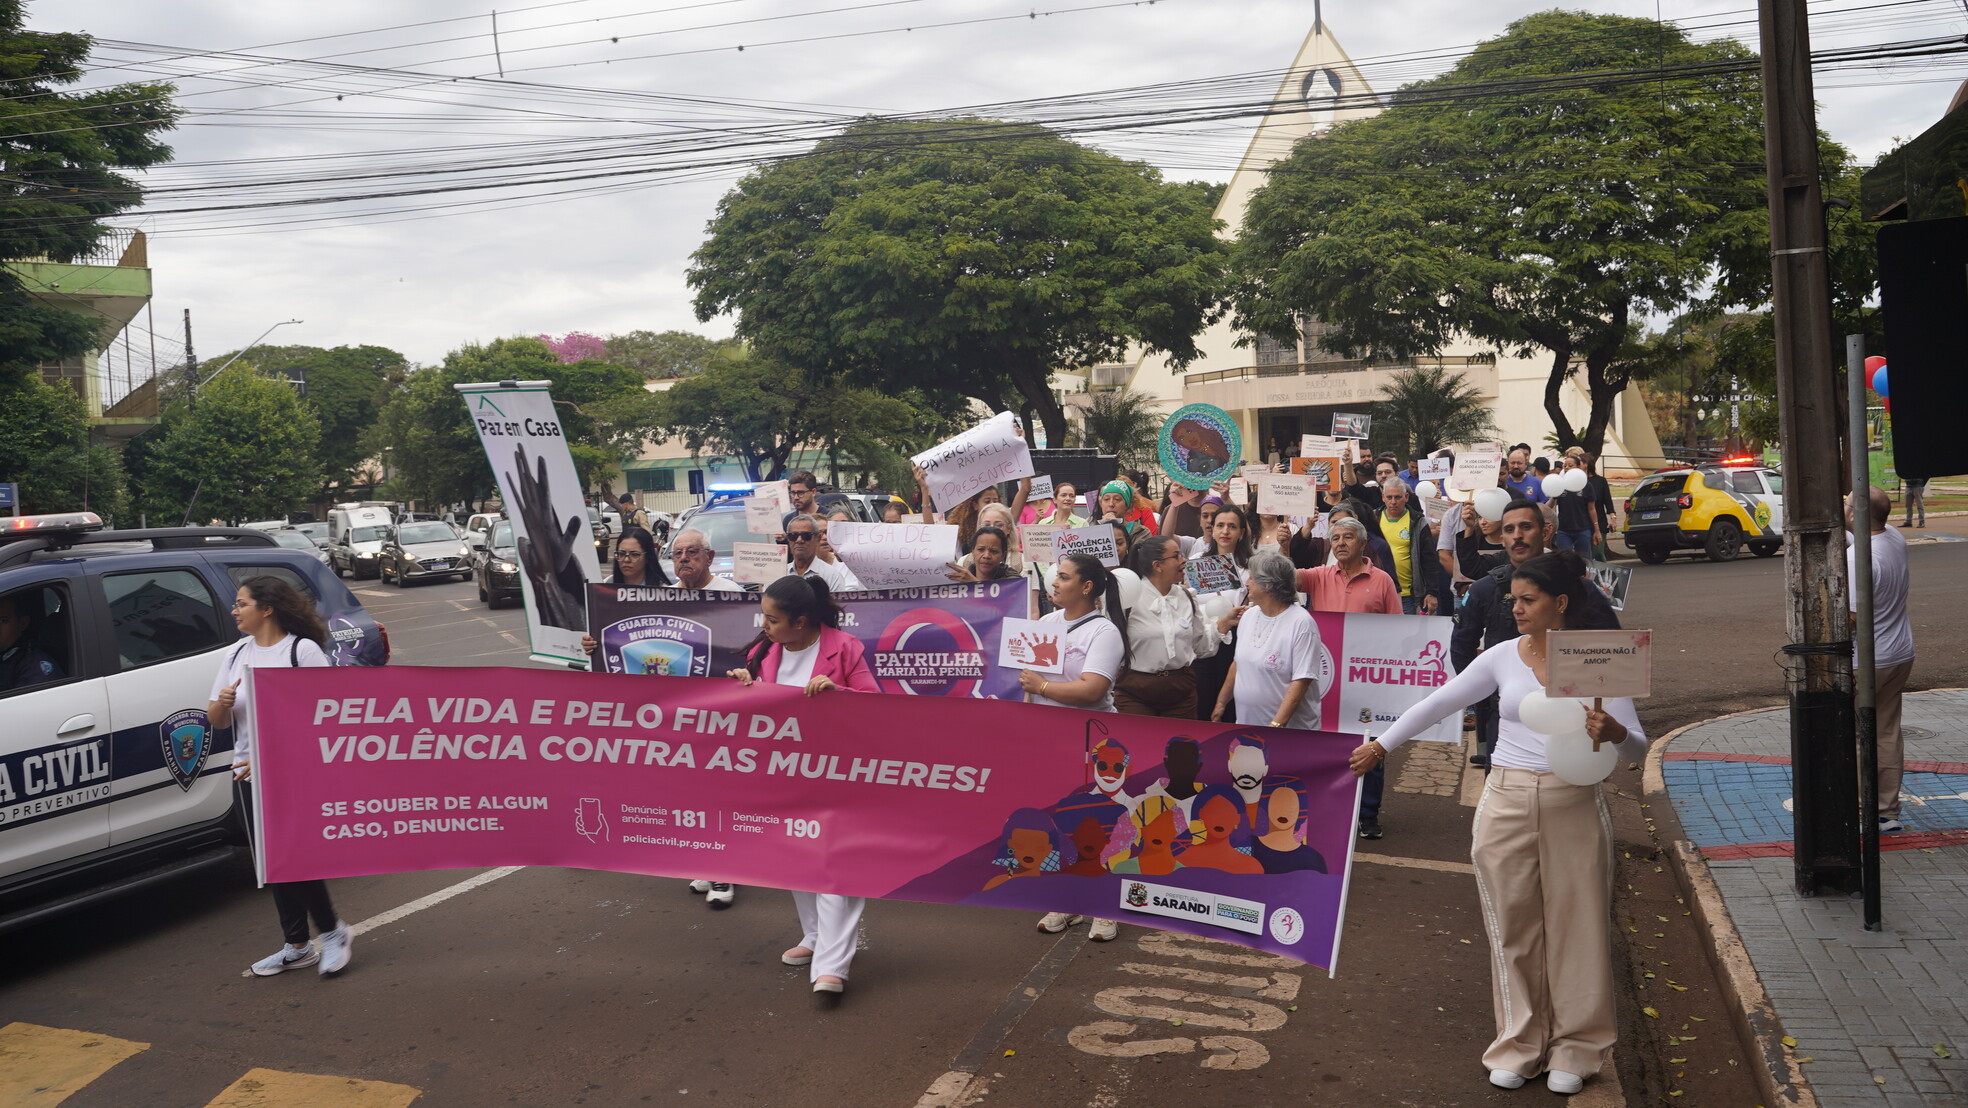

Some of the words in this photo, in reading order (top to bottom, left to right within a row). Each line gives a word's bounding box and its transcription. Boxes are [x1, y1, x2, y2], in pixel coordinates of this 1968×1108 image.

[1337, 389, 1352, 398] DAS
[478, 419, 503, 436] Paz
[505, 421, 523, 437] em
[525, 418, 560, 437] Casa
[957, 438, 1011, 468] RAFAELA
[828, 526, 896, 546] CHEGA
[905, 526, 932, 544] DE
[1057, 532, 1079, 547] Não
[1068, 537, 1111, 548] VIOLÊNCIA
[1067, 547, 1099, 555] CONTRA
[1196, 560, 1217, 571] NÃO
[617, 587, 700, 602] DENUNCIAR
[720, 590, 742, 602] UM
[889, 584, 968, 600] PROTEGER
[990, 583, 1000, 598] O
[618, 617, 663, 632] GUARDA
[666, 618, 695, 633] CIVIL
[628, 629, 683, 641] MUNICIPAL
[1613, 647, 1630, 655] NÃO
[1632, 646, 1636, 655] É
[874, 652, 984, 668] PATRULHA
[1350, 657, 1403, 667] SECRETARIA
[1583, 657, 1611, 665] AMOR"
[877, 667, 917, 677] MARIA
[919, 667, 934, 677] DA
[936, 667, 983, 677] PENHA
[1348, 666, 1448, 687] MULHER
[313, 697, 414, 725] PELA
[427, 697, 518, 725] VIDA
[529, 699, 555, 725] E
[563, 700, 663, 730] PELO
[672, 706, 738, 736] FIM
[747, 713, 803, 742] DA
[1375, 714, 1400, 722] SARA
[22, 740, 109, 796] CIVIL
[318, 728, 527, 763] VIOLÊNCIA
[539, 736, 696, 769] CONTRA
[705, 745, 758, 773] AS
[767, 750, 991, 793] MULHERES!
[13, 785, 110, 819] PREVENTIVO
[321, 800, 348, 816] SE
[353, 797, 438, 815] SOUBER
[444, 796, 472, 812] DE
[477, 796, 548, 812] ALGUM
[621, 803, 668, 816] Denúncia
[621, 813, 667, 827] anônima:
[671, 808, 706, 829] 181
[733, 811, 779, 825] Denúncia
[322, 823, 388, 841] CASO,
[393, 817, 504, 835] DENUNCIE.
[733, 822, 764, 834] crime:
[784, 817, 820, 839] 190
[623, 834, 726, 851] policiacivil.pr.gov.br
[1152, 895, 1210, 915] SARANDI
[1165, 892, 1199, 903] PREFEITURA
[1216, 910, 1233, 919] PARA
[1233, 912, 1239, 920] O
[1218, 903, 1259, 916] GOVERNANDO
